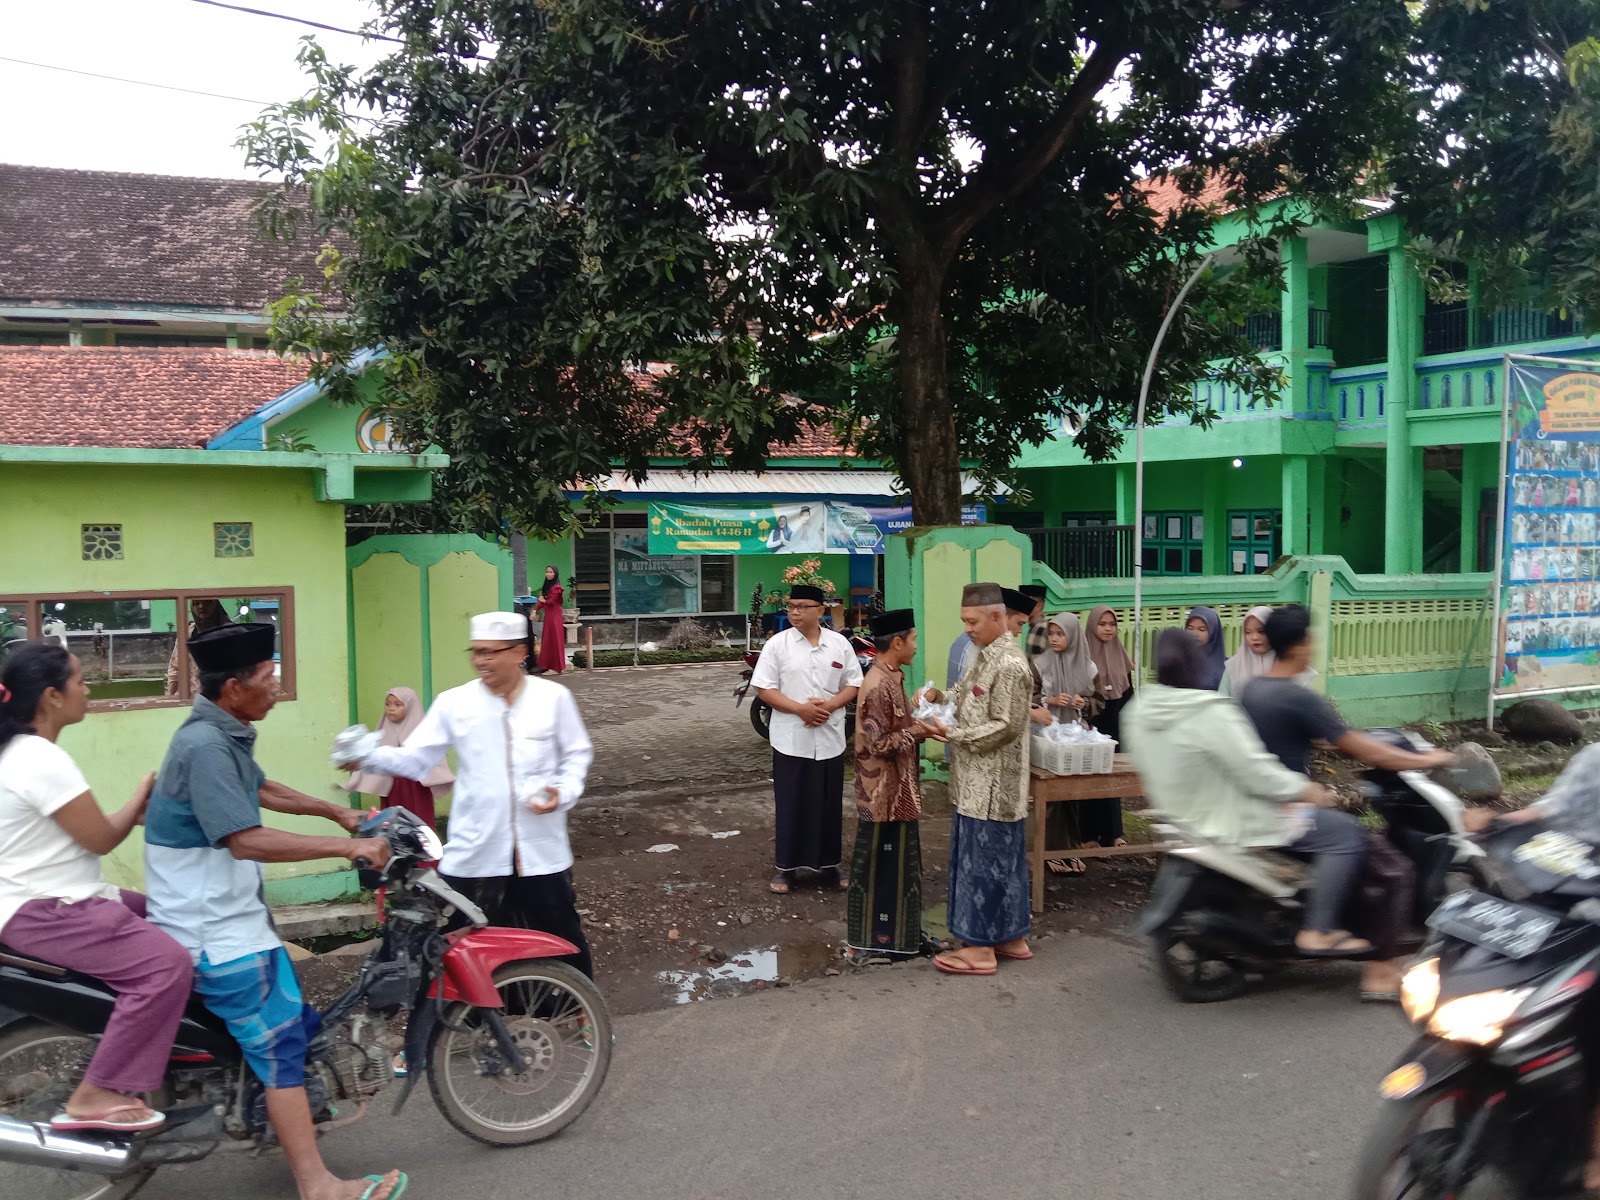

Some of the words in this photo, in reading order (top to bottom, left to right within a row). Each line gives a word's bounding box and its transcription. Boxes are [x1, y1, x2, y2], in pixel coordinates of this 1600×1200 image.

[675, 517, 711, 527] Ibadah
[713, 518, 743, 527] Puasa
[665, 527, 713, 536] Ramadan
[716, 527, 741, 536] 1446
